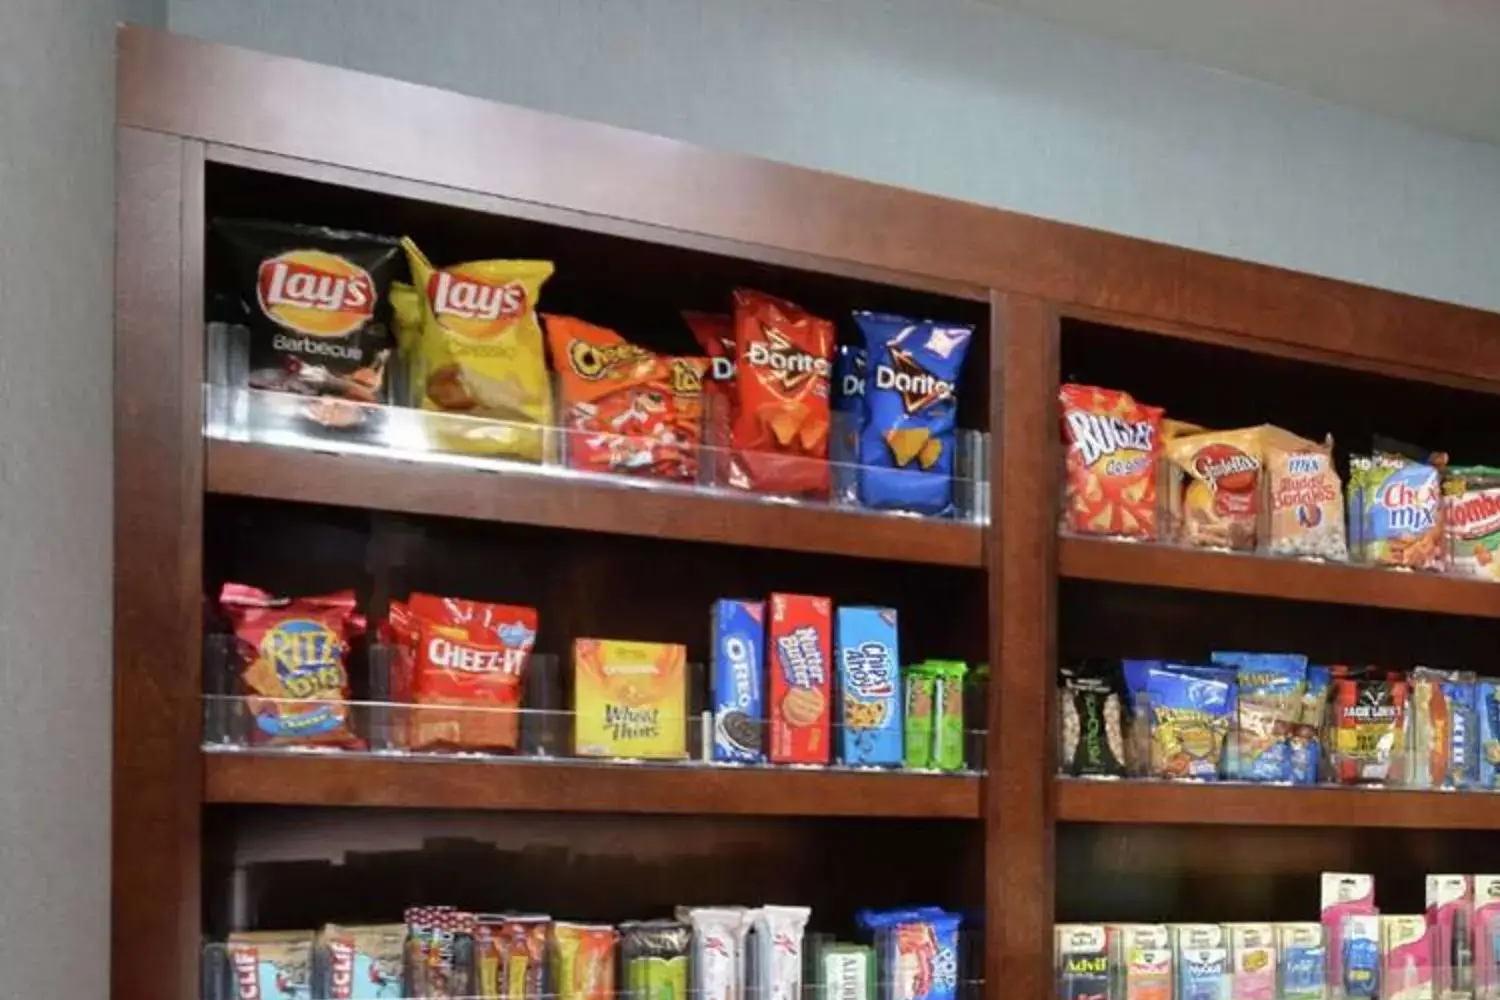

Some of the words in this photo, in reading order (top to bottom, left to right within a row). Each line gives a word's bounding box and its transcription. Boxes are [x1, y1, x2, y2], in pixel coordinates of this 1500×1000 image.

[267, 262, 368, 310] Lay's
[434, 271, 526, 321] Lay's
[272, 332, 364, 361] Barbecue
[263, 631, 341, 669] RITZ
[727, 637, 750, 707] OREO
[602, 721, 660, 742] Thins
[605, 704, 659, 724] Wheat
[331, 942, 354, 991] CLIF
[1066, 957, 1107, 973] Advil
